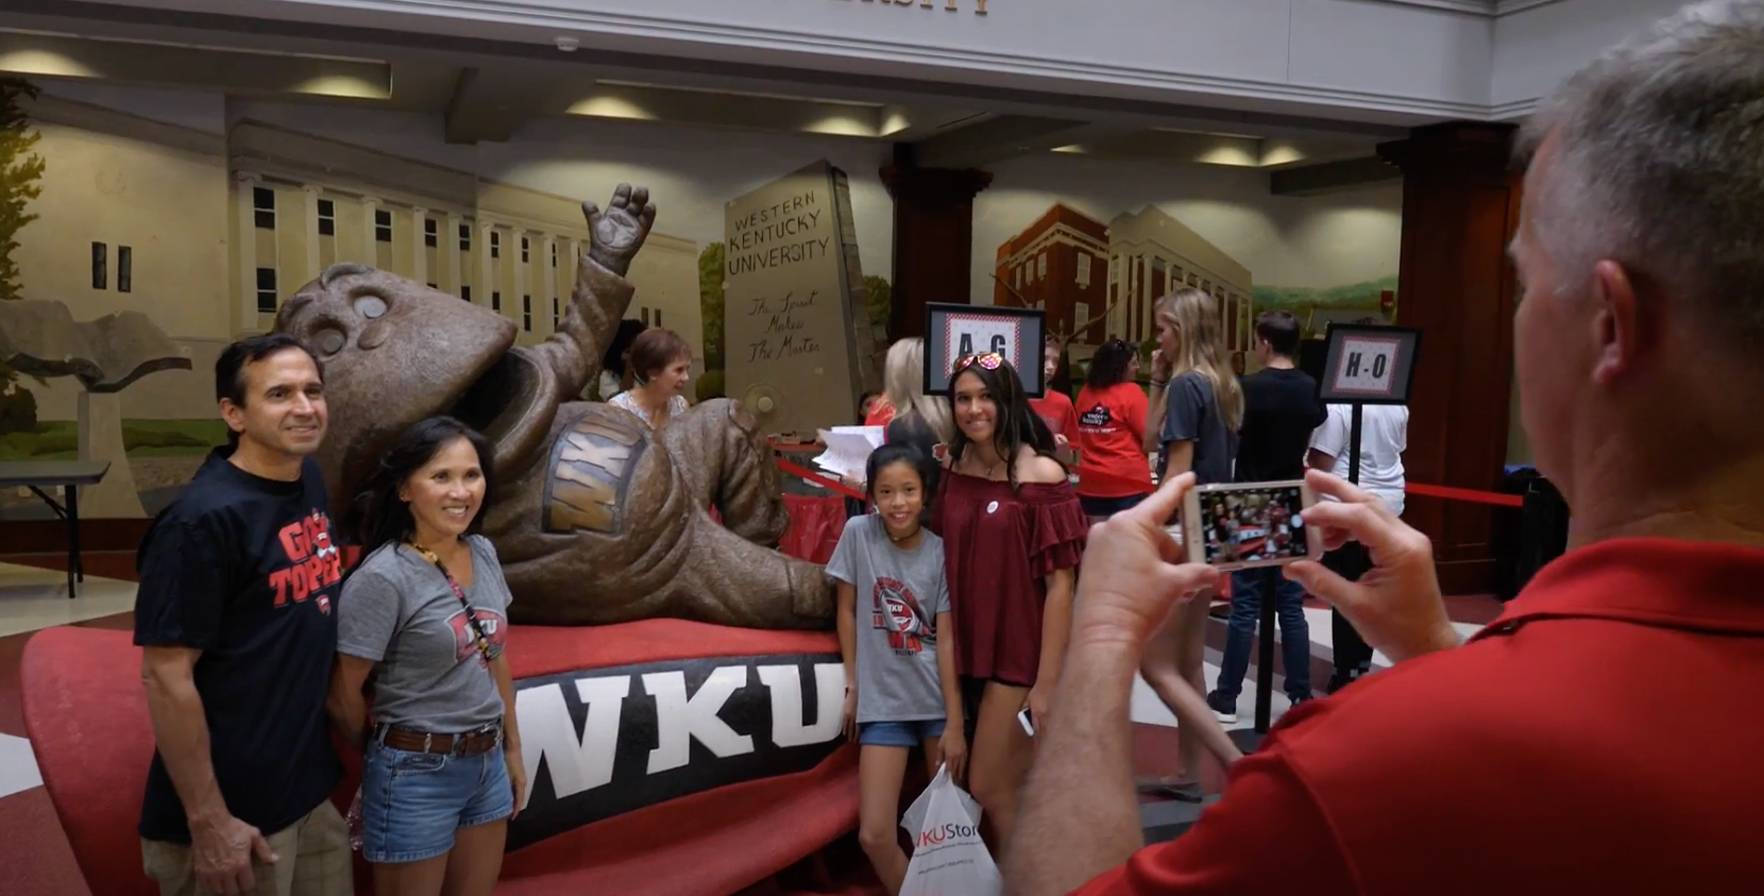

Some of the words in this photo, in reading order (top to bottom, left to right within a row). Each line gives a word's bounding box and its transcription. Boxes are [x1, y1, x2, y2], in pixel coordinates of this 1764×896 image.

[729, 209, 822, 253] KENTUCKY
[735, 190, 815, 231] WESTERN
[728, 237, 830, 275] UNIVERSITY
[749, 297, 771, 315] The
[748, 339, 772, 363] The
[775, 335, 820, 361] Master
[550, 411, 642, 533] WKU
[515, 663, 848, 810] WKU
